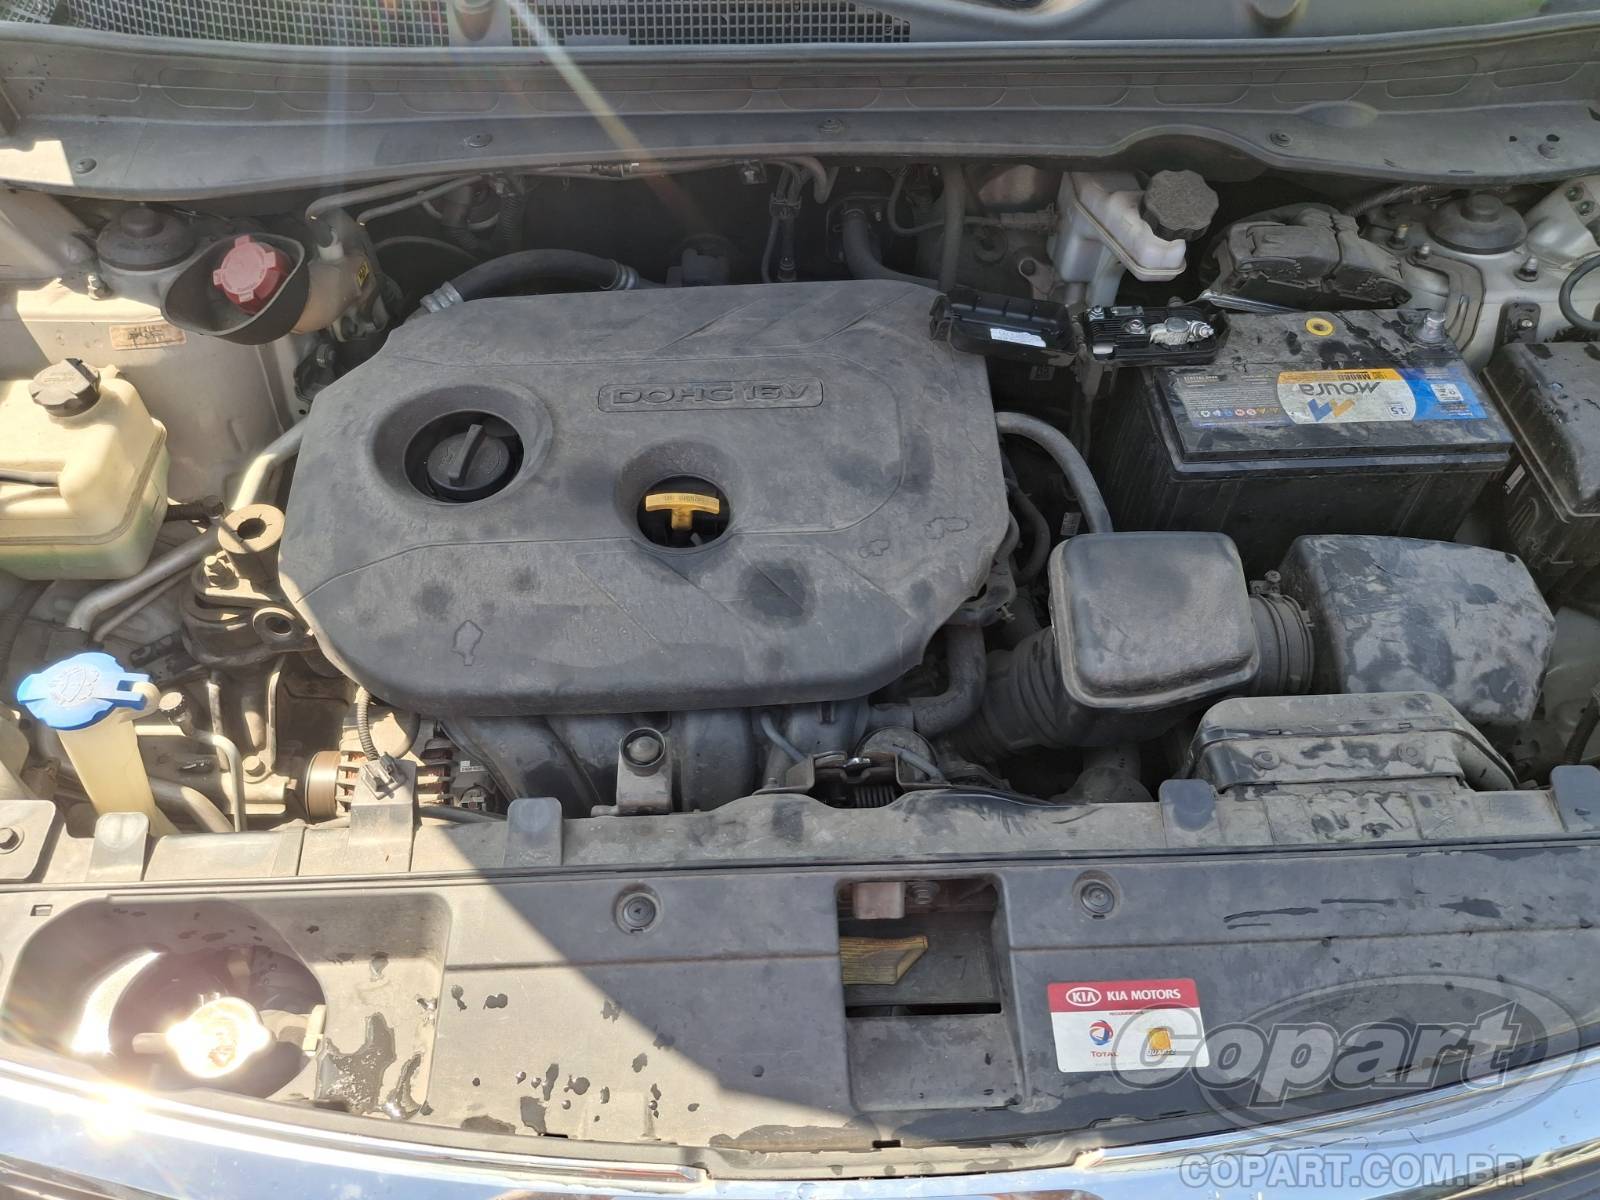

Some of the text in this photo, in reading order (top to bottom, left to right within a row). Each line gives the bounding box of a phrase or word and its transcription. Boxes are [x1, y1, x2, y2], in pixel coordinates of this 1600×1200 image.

[612, 384, 809, 404] DOHC 16V
[1071, 992, 1096, 1003] KIA
[1106, 988, 1182, 1001] KIA MOTORS
[1090, 1050, 1119, 1058] TOTAL
